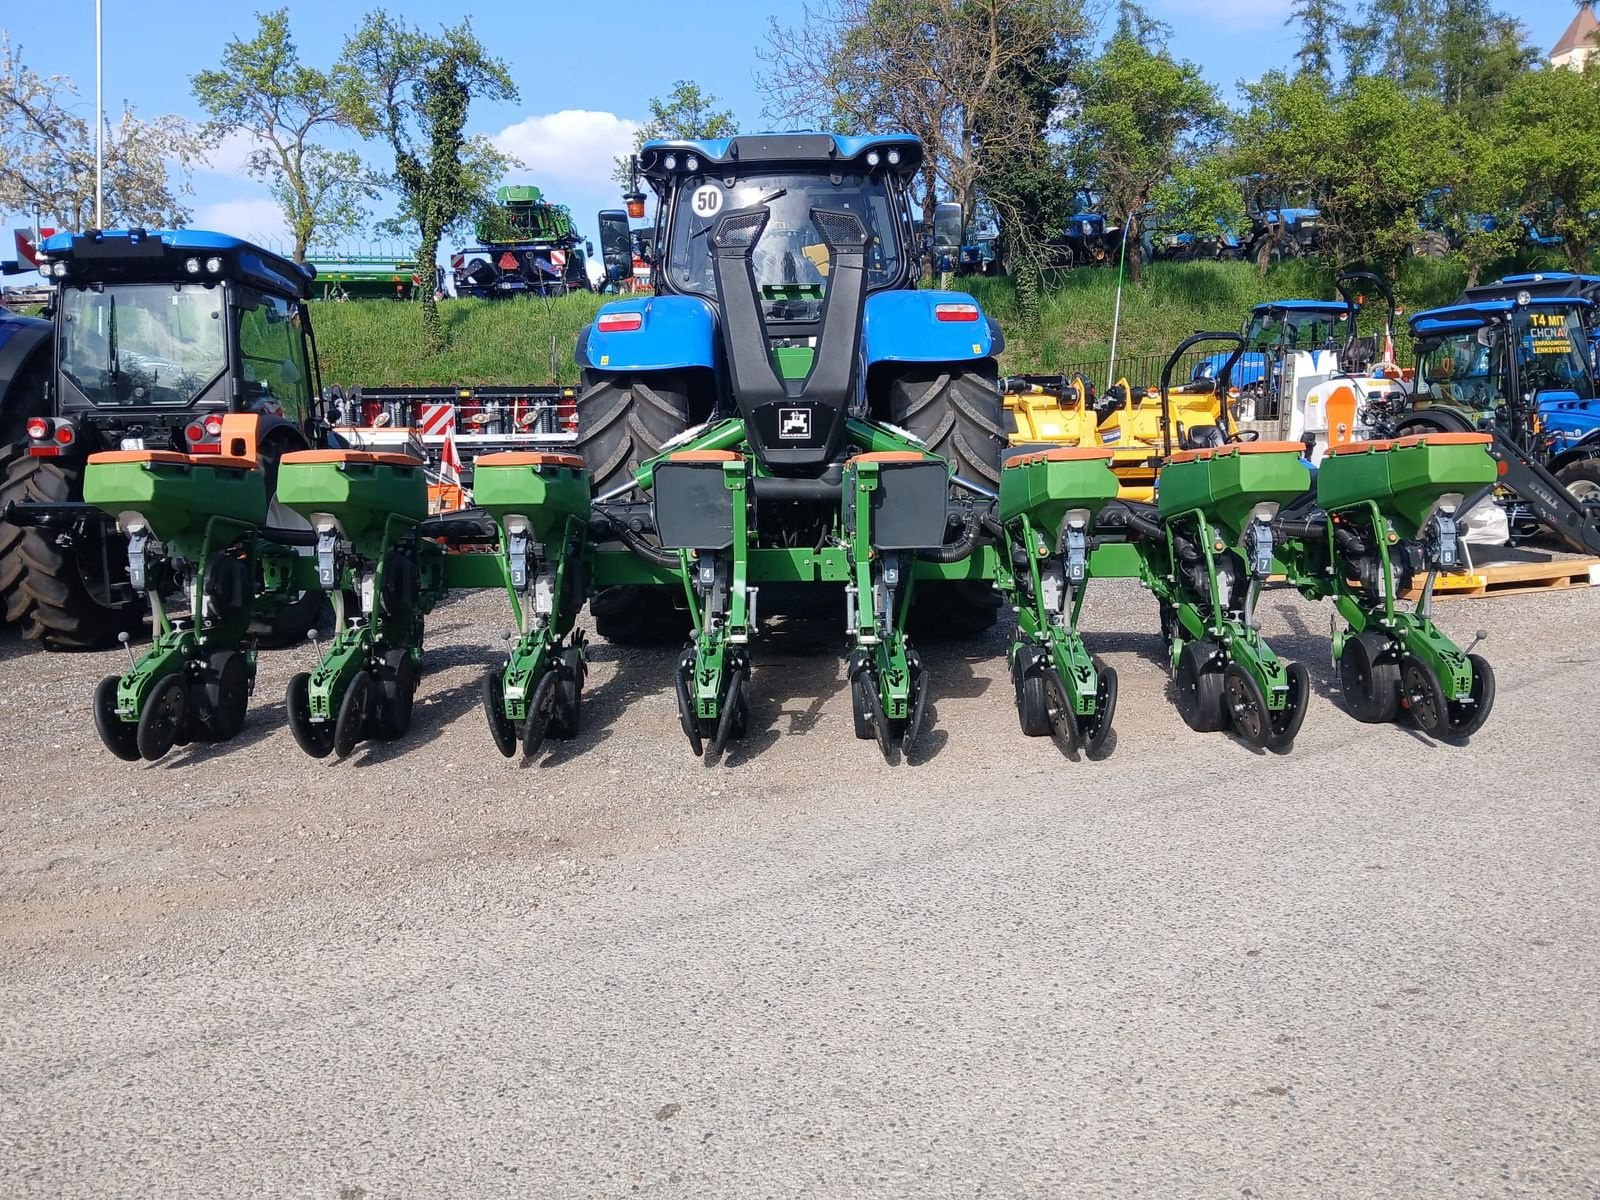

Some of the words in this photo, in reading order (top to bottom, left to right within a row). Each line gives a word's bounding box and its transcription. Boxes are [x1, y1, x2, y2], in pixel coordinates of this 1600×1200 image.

[698, 191, 717, 210] 50
[1530, 314, 1546, 326] T4
[1548, 315, 1565, 326] MIT
[1445, 552, 1451, 562] 8
[1262, 559, 1268, 570] 7
[134, 571, 139, 580] 1
[323, 570, 330, 581] 2
[514, 571, 521, 582] 3
[703, 569, 710, 578] 4
[889, 568, 896, 578] 5
[1073, 567, 1080, 576] 6
